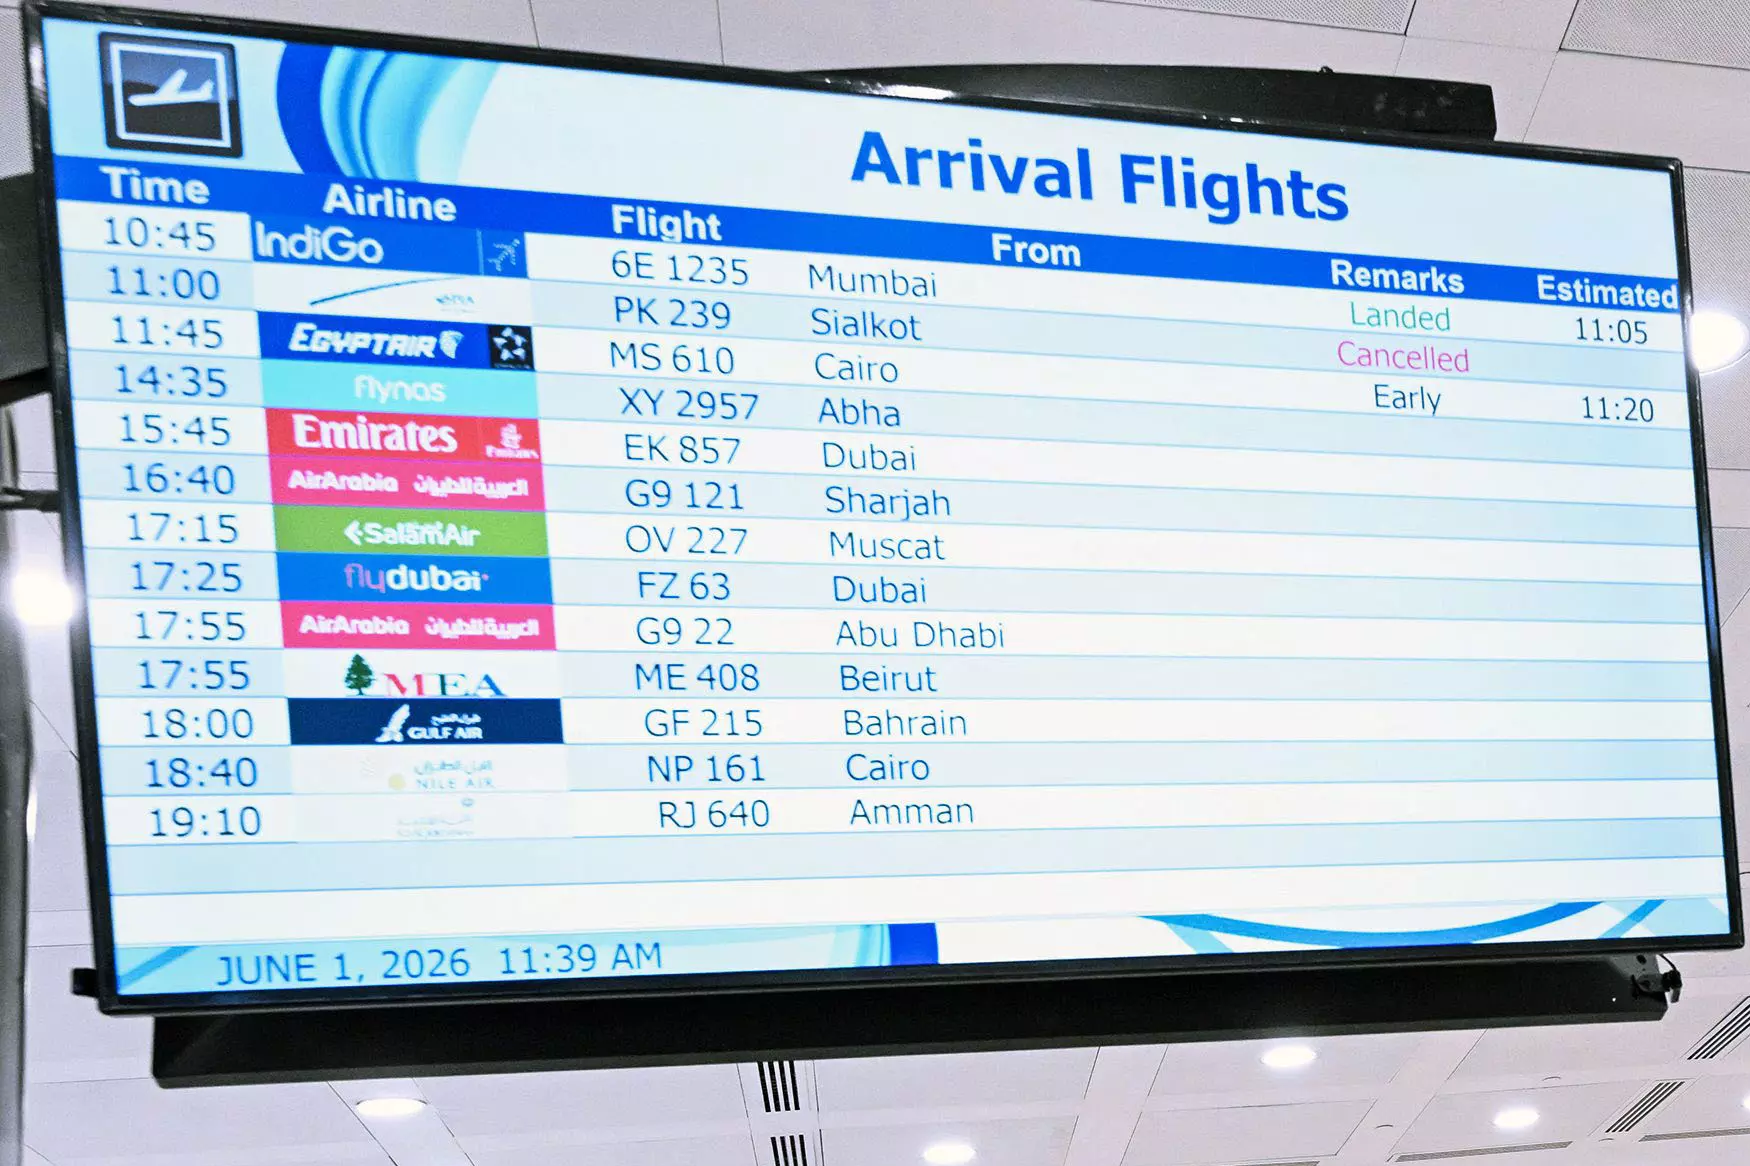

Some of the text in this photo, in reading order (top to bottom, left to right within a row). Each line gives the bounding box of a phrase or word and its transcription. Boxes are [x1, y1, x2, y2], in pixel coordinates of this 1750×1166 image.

[850, 130, 1350, 226] Arrival Flights
[99, 165, 1678, 310] Time Airline Flight From Remarks Estimated
[105, 216, 1648, 345] 10:45 IndiGo 6E 1235 Mumbai Landed 11:05
[108, 265, 1470, 373] 11:00 PK 239 Sialkot Cancelled
[112, 315, 223, 349] 11:45
[611, 342, 661, 372] MS
[672, 345, 735, 375] 610
[815, 353, 898, 383] Cairo
[1374, 384, 1441, 417] Early
[1583, 396, 1653, 423] 11:20
[116, 364, 901, 428] 14:35 flynas XY 2957 Abha
[120, 414, 231, 446] 15:45
[292, 414, 457, 453] Emirates
[625, 433, 668, 462] EK
[680, 435, 741, 465] 857
[822, 441, 917, 471] Dubai
[124, 463, 235, 496] 16:40
[626, 479, 951, 522] G9 121 Sharjah
[128, 512, 239, 544] 17:15
[626, 525, 674, 554] OV
[687, 527, 748, 555] 227
[830, 532, 945, 561] Muscat
[132, 561, 926, 603] 17:25 flydubai FZ 63 Dubai
[135, 611, 246, 641] 17:55
[637, 618, 1005, 649] G9 22 Abu Dhabi
[139, 660, 938, 697] 17:55 MEA ME 408 Beirut
[143, 708, 967, 739] 18:00 GULF AIR GF 215 Bahrain
[147, 757, 257, 788] 18:40
[648, 755, 693, 783] NP
[708, 755, 765, 783] 161
[846, 753, 930, 781] Cairo
[150, 800, 973, 837] 19:10 RJ 640 Amman
[217, 942, 662, 986] JUNE 1, 2026 11:39 AM
